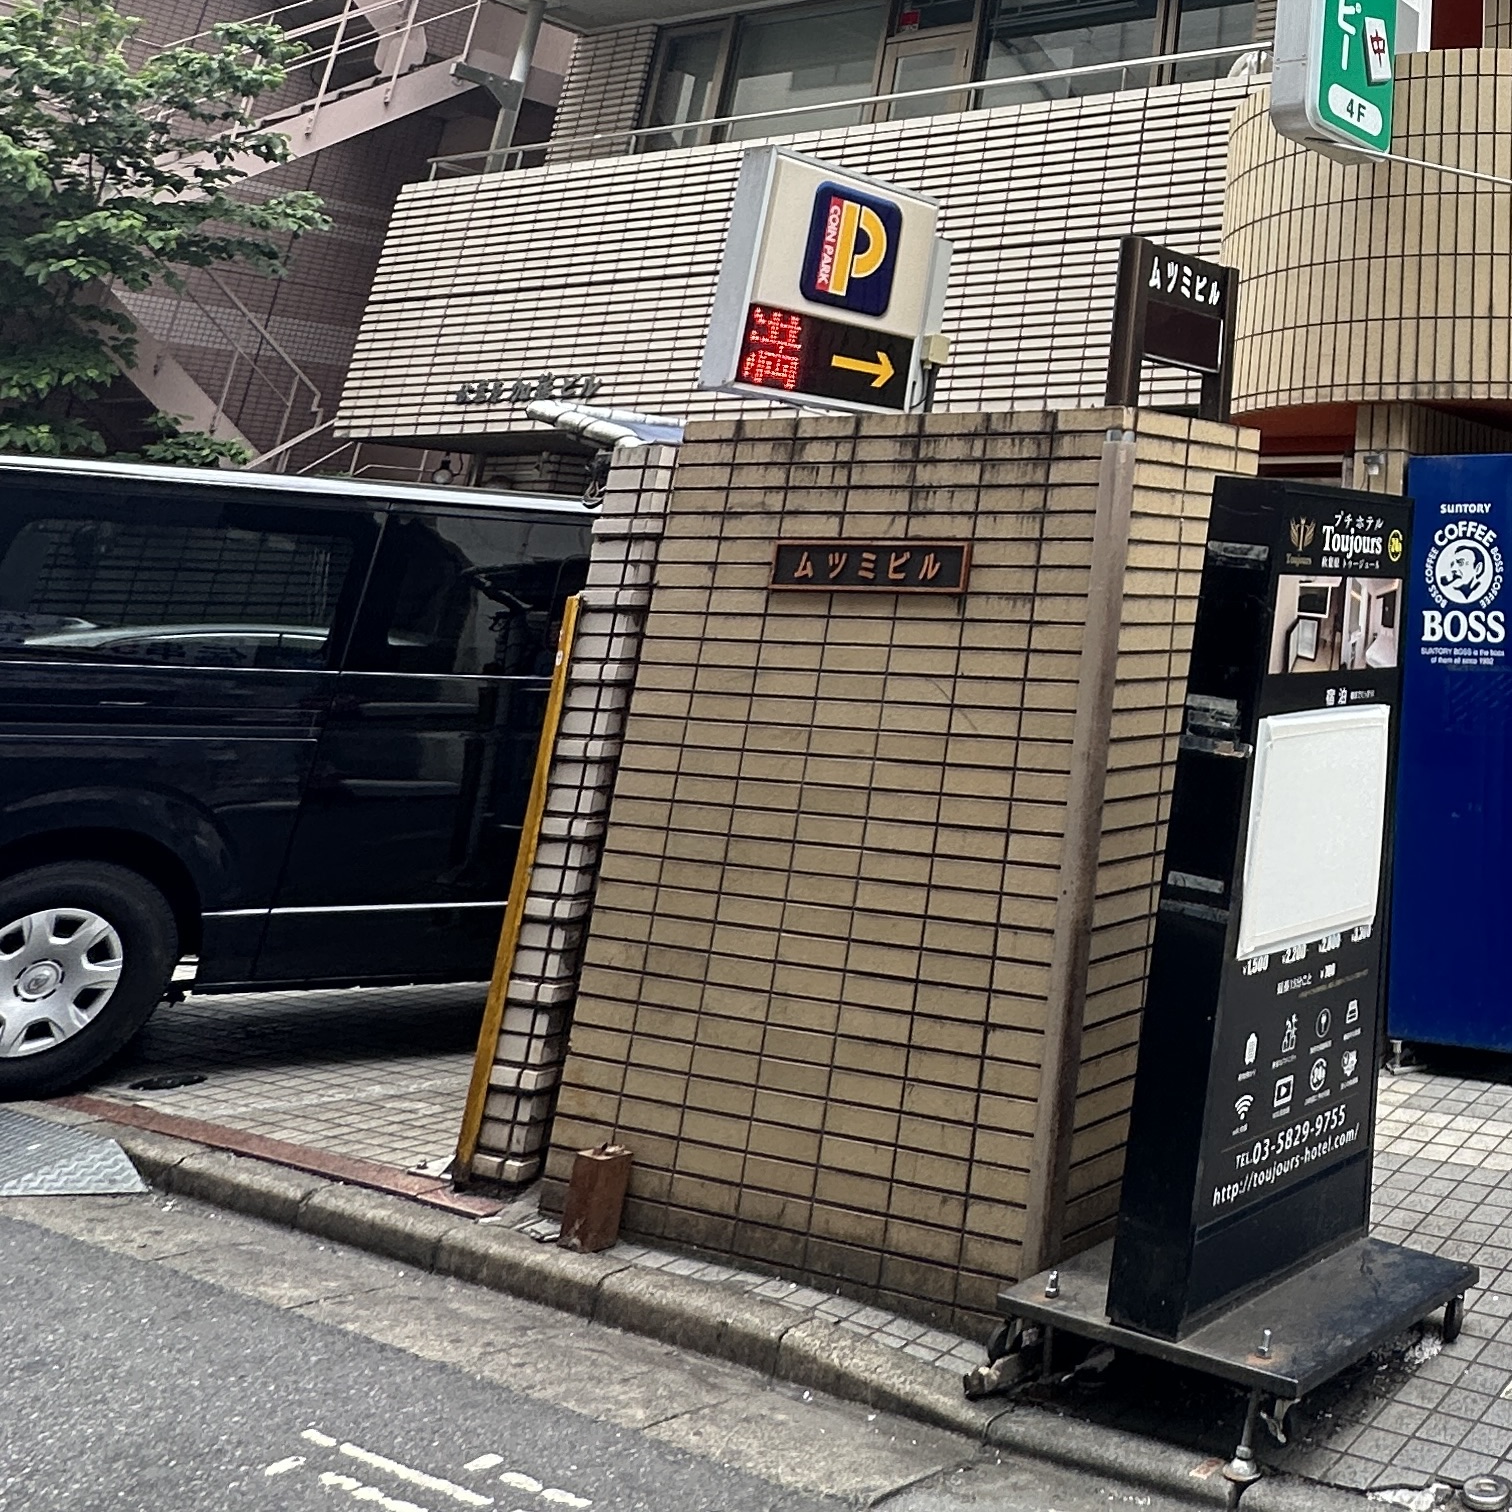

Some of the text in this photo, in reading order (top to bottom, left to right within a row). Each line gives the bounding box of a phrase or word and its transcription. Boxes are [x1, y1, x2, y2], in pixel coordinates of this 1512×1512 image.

[1346, 98, 1367, 123] 4F
[817, 205, 842, 286] COIN PARK
[1148, 255, 1221, 306] ムツミビル
[1322, 525, 1383, 559] Toujours
[1434, 521, 1498, 548] COFFEE
[794, 551, 941, 580] ムツミビル
[1425, 546, 1449, 609] BOSS COFFEE
[1478, 545, 1505, 609] BOSS COFFEE
[1421, 610, 1506, 643] BOSS
[1212, 1121, 1360, 1207] http://toujours-hotel.com/
